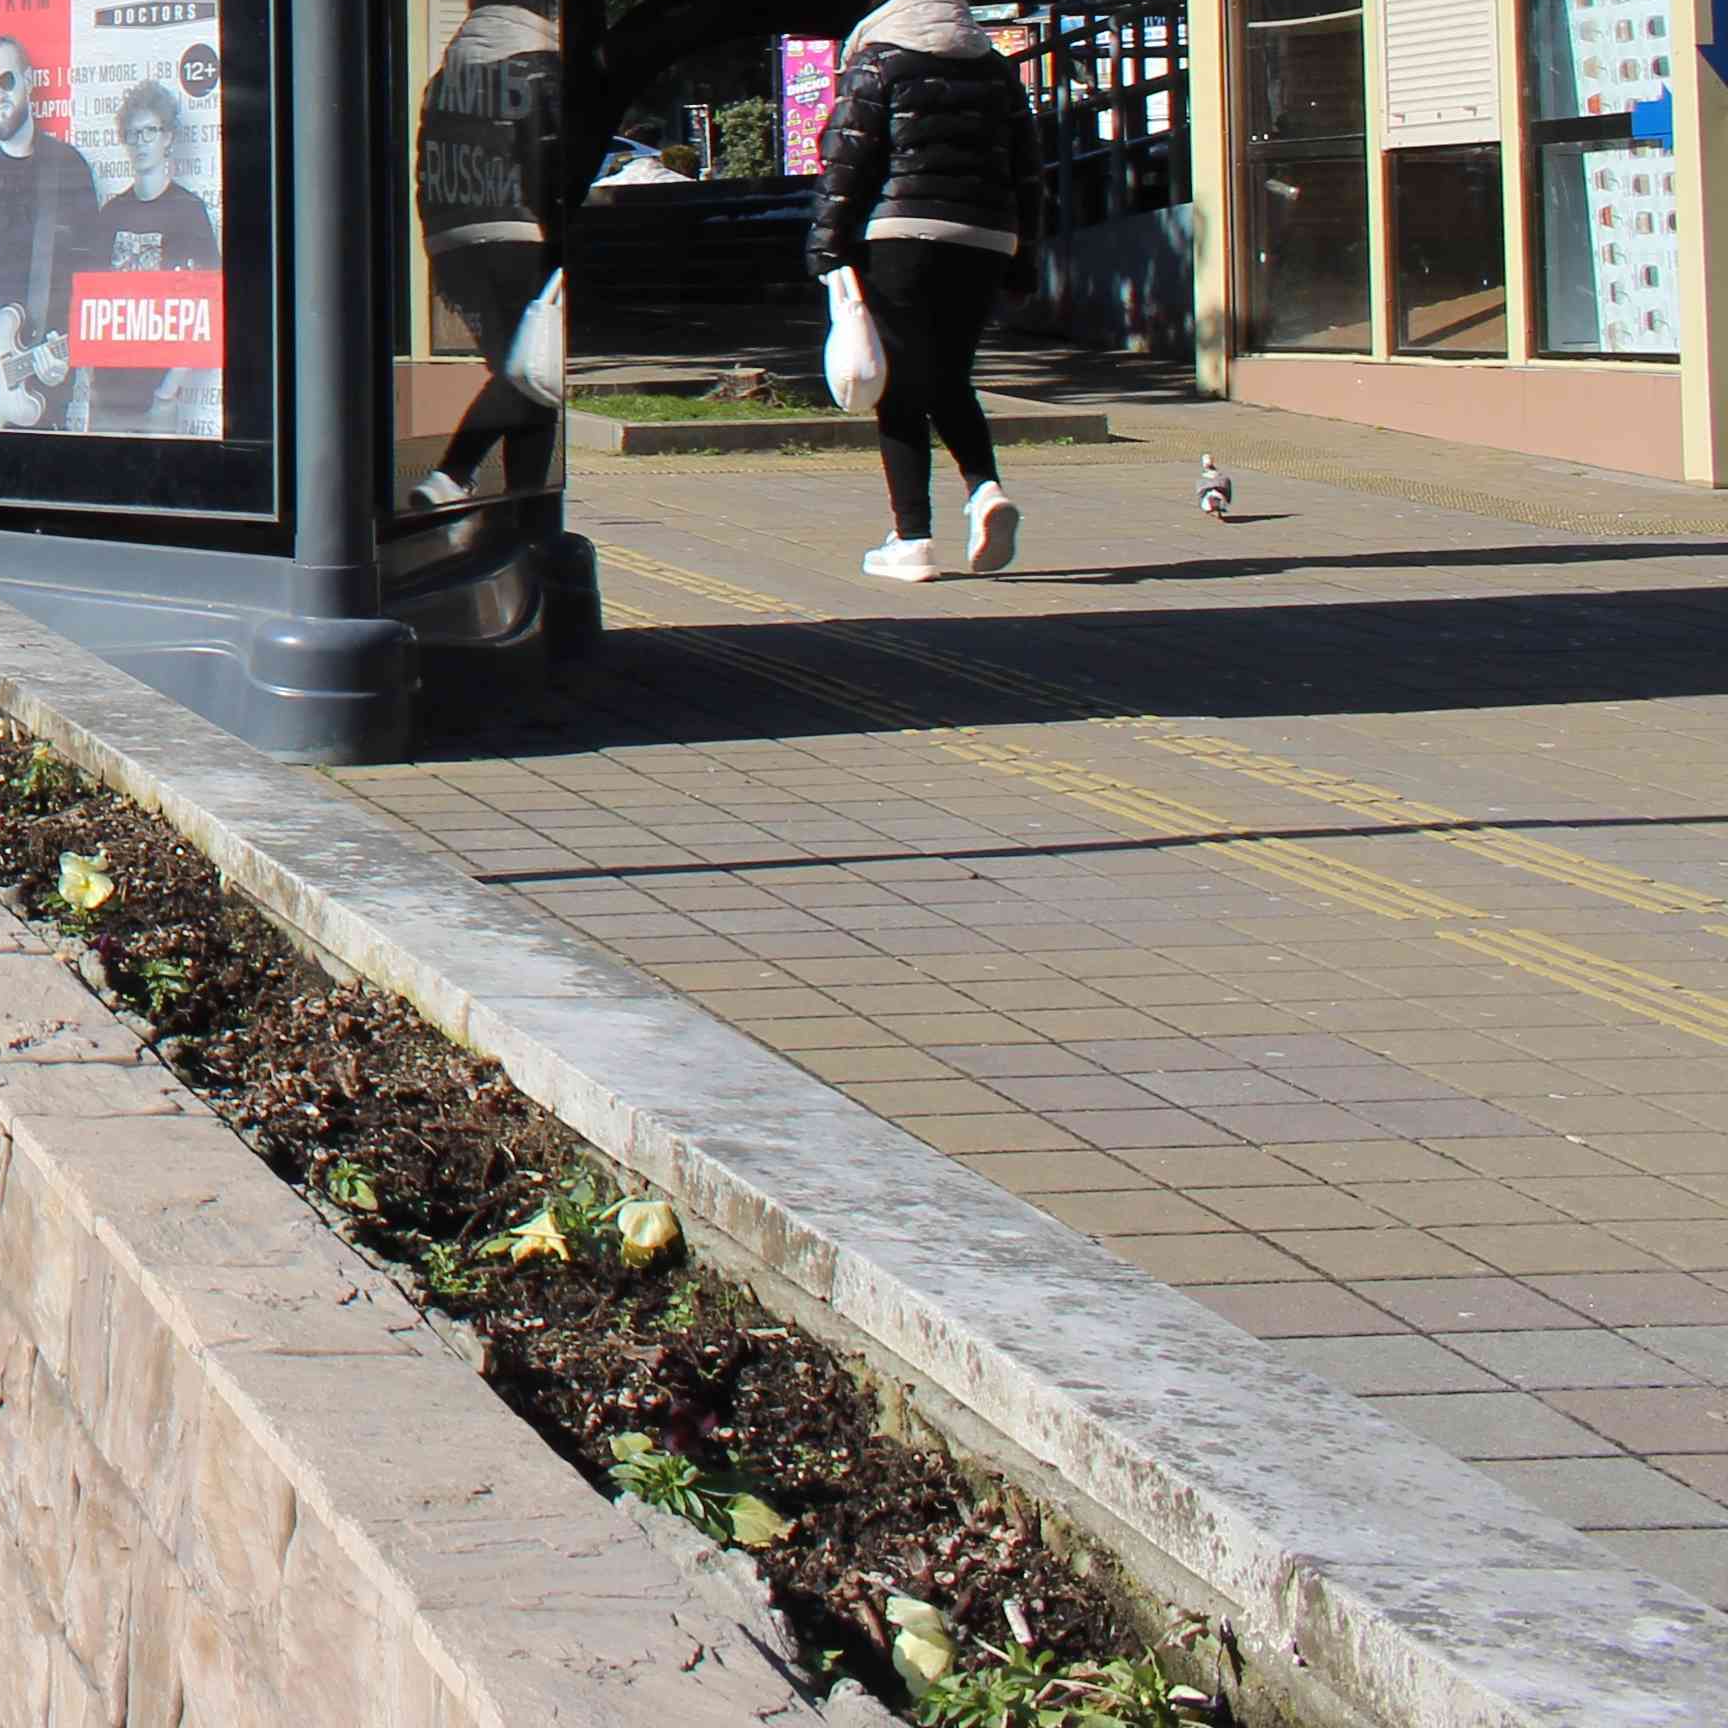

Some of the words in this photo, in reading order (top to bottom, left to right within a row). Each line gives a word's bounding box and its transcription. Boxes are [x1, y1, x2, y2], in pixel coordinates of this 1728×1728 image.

[114, 4, 198, 26] DOCTORS
[183, 61, 216, 81] 12+
[80, 299, 211, 342] ПРЕМЬЕРА
